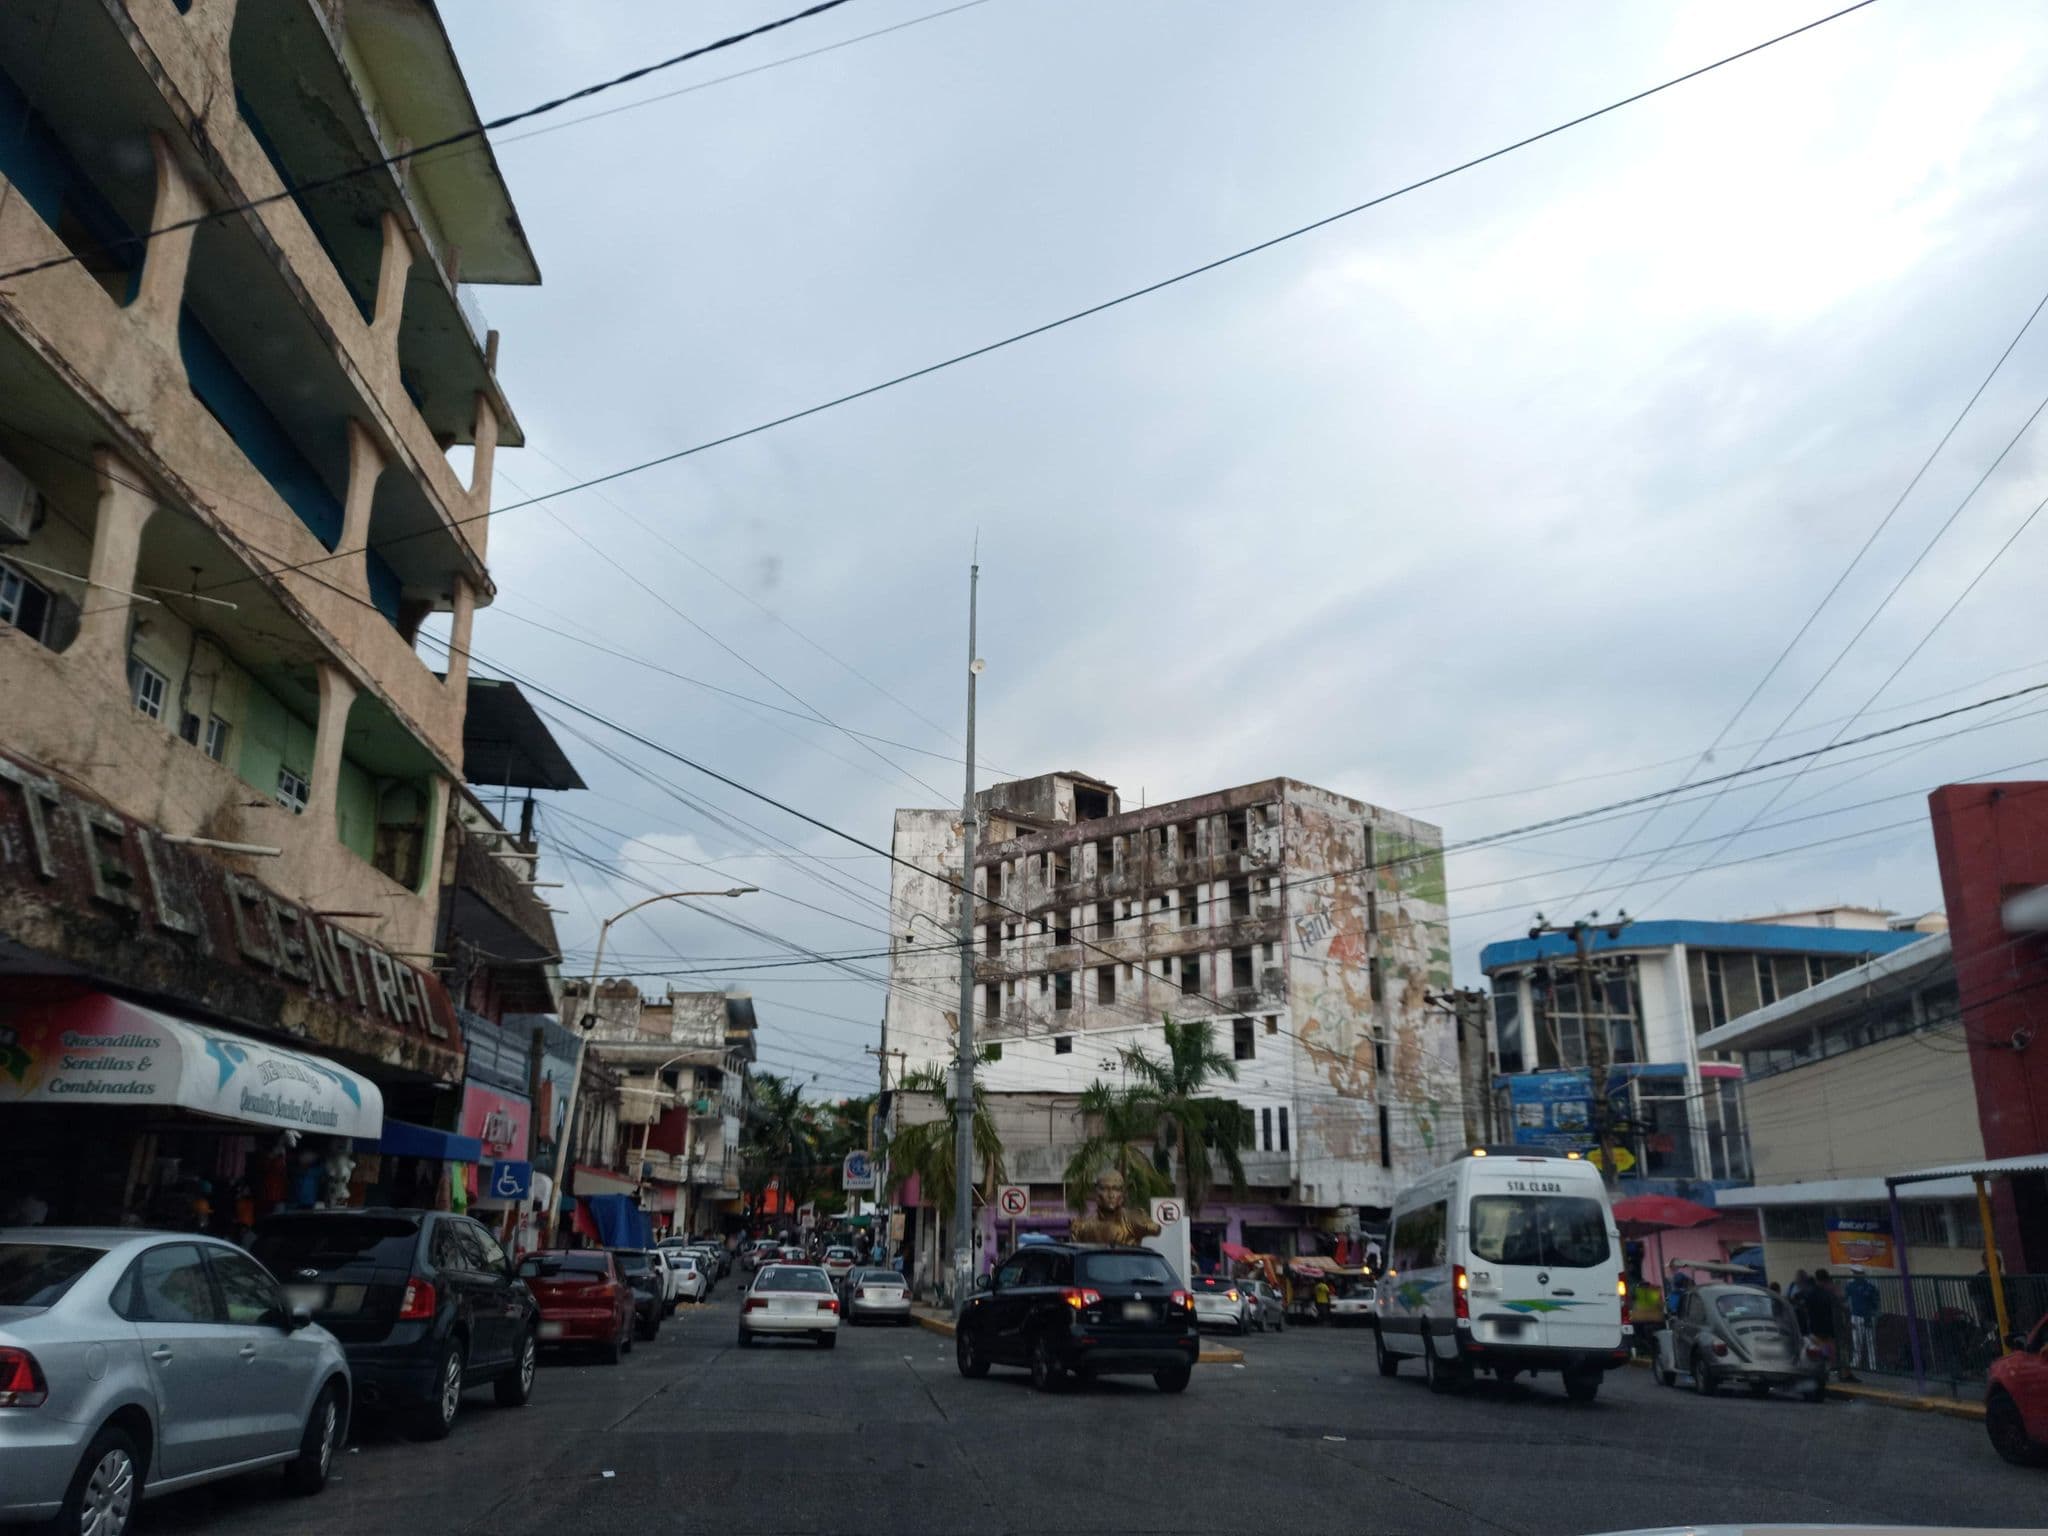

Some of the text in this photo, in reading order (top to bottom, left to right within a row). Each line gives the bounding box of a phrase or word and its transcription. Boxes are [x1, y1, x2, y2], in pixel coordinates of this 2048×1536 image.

[224, 872, 449, 1042] CENTRAL
[61, 1030, 161, 1049] Quesadillas
[60, 1054, 135, 1071] Sencillas
[48, 1078, 156, 1095] Combinadas
[1529, 1182, 1563, 1193] CLARA
